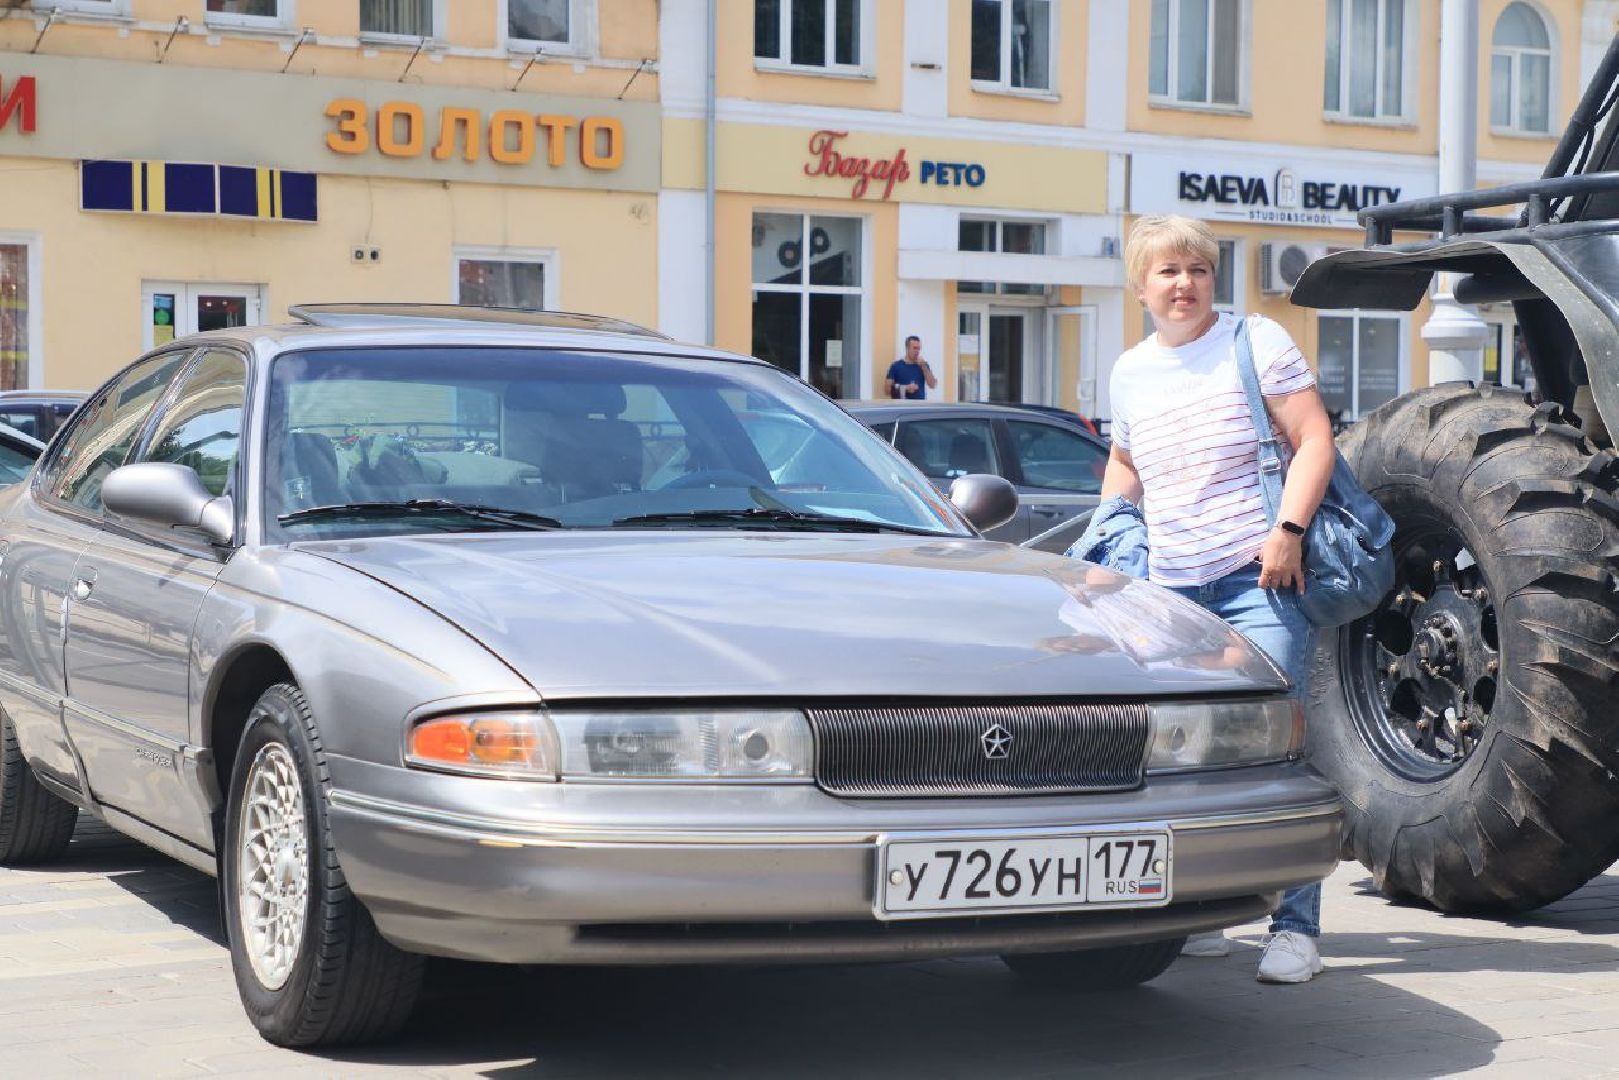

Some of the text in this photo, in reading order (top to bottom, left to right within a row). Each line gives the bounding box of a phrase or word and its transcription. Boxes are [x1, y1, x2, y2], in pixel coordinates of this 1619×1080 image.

[325, 99, 625, 170] ЗОЛОТО
[804, 130, 911, 200] Базар
[1178, 170, 1402, 212] ISAEVA BEAUTY
[1094, 839, 1157, 878] 177
[1105, 880, 1138, 895] RUS
